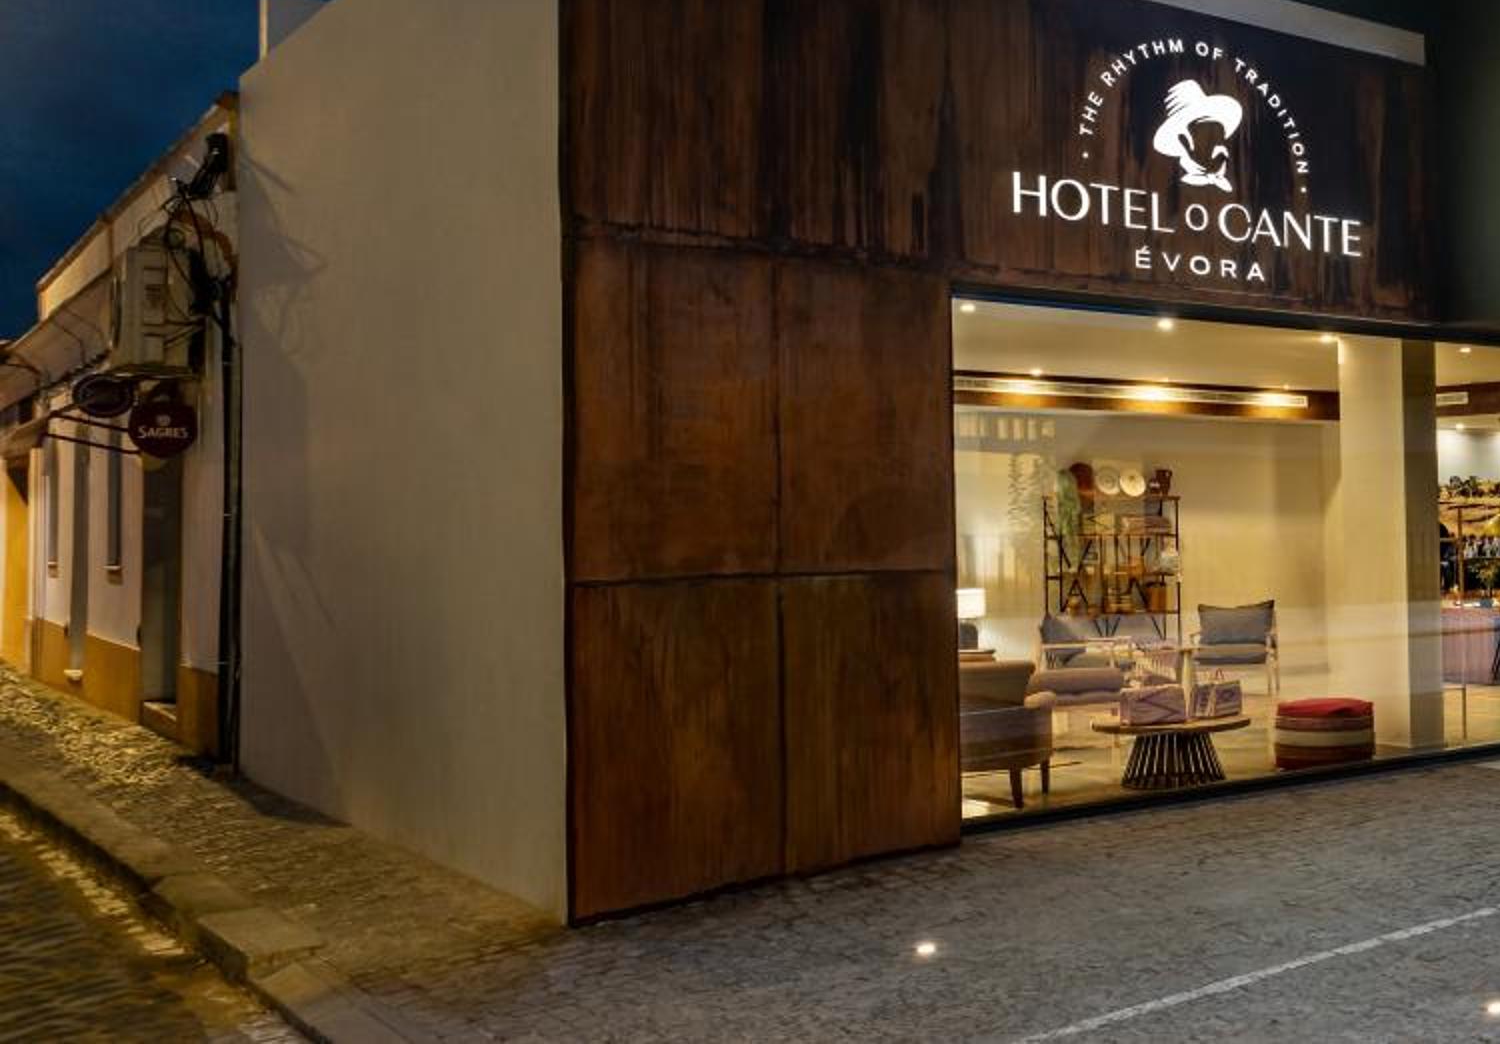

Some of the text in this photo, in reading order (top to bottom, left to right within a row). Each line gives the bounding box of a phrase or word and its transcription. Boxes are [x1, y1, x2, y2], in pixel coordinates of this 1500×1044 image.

[1079, 38, 1310, 174] THE RHYTHM OF TRADITION
[1012, 171, 1176, 235] HOTEL
[1217, 203, 1363, 257] CANTE
[1134, 245, 1266, 280] ÉVORA
[137, 425, 189, 439] SAGRES
